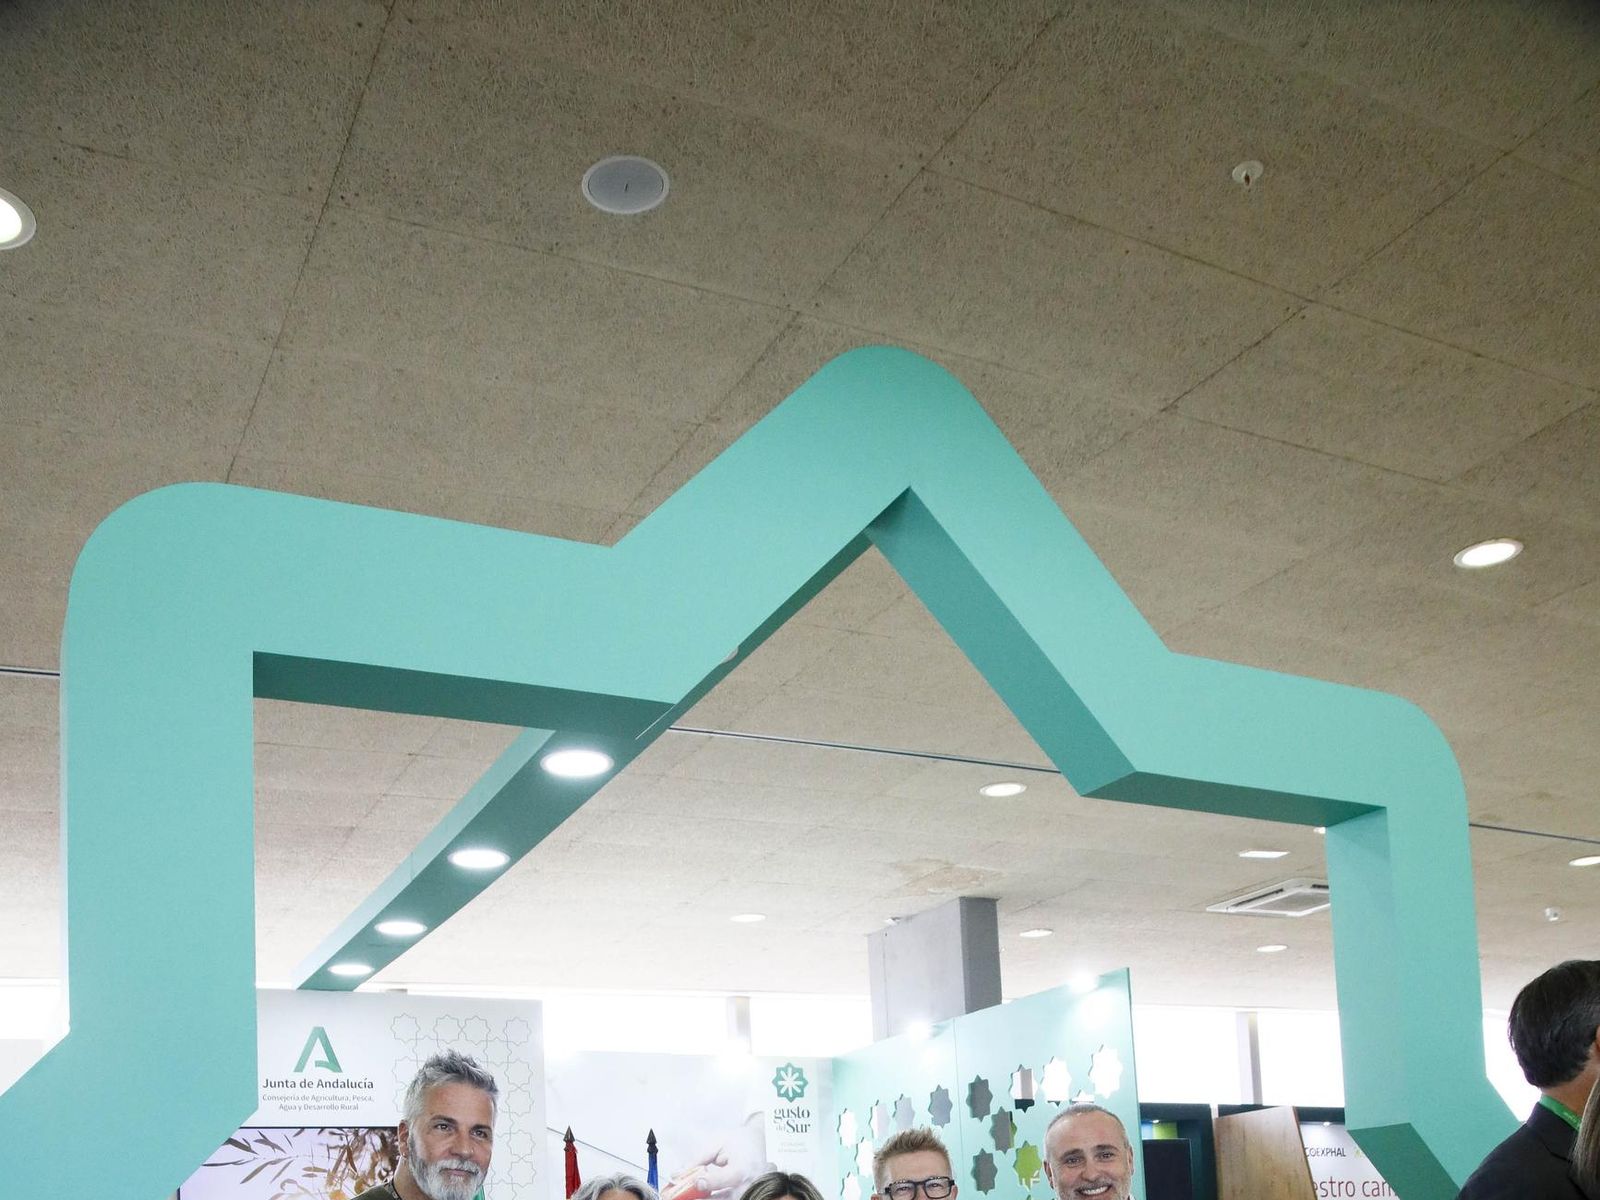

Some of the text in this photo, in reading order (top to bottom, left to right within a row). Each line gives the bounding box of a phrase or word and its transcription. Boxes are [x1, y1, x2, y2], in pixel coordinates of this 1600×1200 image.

[262, 1077, 374, 1090] Junta de Andalucía
[301, 1094, 310, 1102] de
[311, 1094, 351, 1103] Agricultura,
[352, 1094, 374, 1103] Pesca,
[279, 1103, 358, 1113] Agua y Desarrollo Rural
[773, 1106, 811, 1124] gusto
[786, 1119, 811, 1134] Sur
